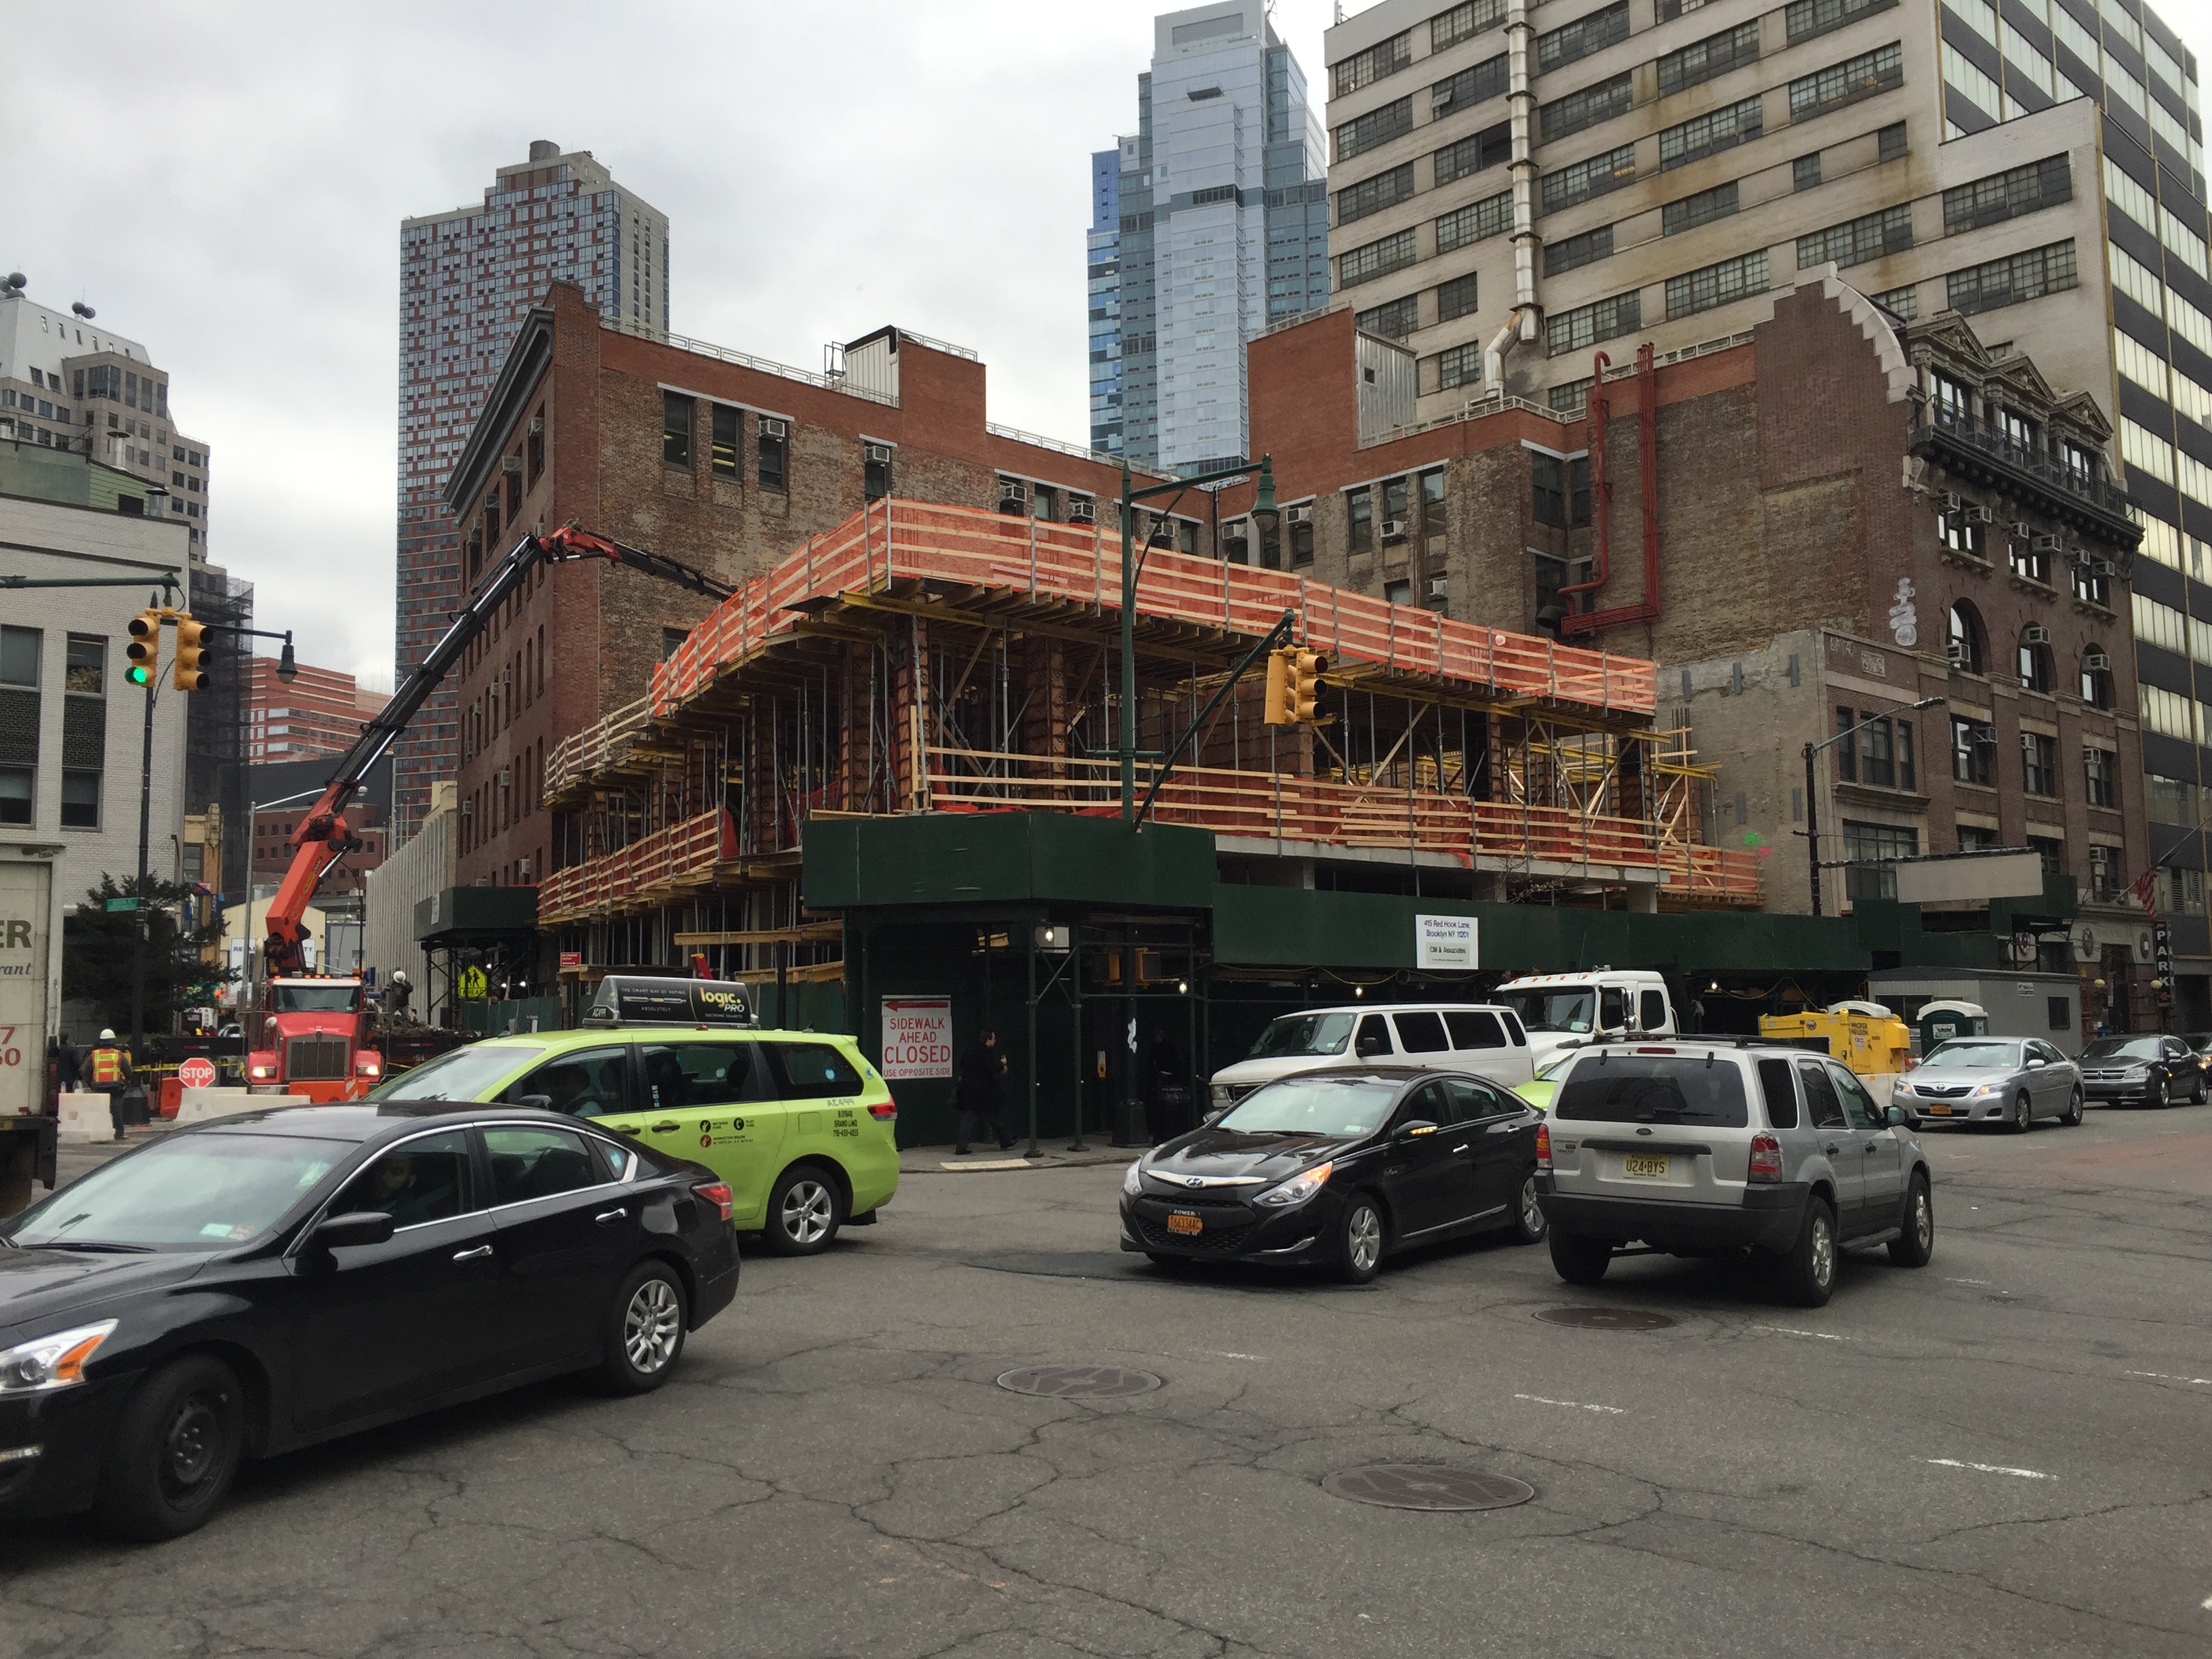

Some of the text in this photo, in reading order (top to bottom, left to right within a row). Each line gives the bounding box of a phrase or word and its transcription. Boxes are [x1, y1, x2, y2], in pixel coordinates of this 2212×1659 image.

[0, 920, 33, 948] R
[1426, 930, 1447, 939] Brooklyn
[2156, 930, 2170, 987] PARK
[724, 1004, 745, 1012] PRO
[890, 1017, 945, 1030] SIDEWALK
[899, 1031, 937, 1043] AHEAD
[0, 1048, 21, 1066] 0
[884, 1045, 951, 1064] CLOSED
[182, 1067, 213, 1079] STOP
[899, 1068, 934, 1076] OPPOSITE
[935, 1067, 951, 1076] SIDE
